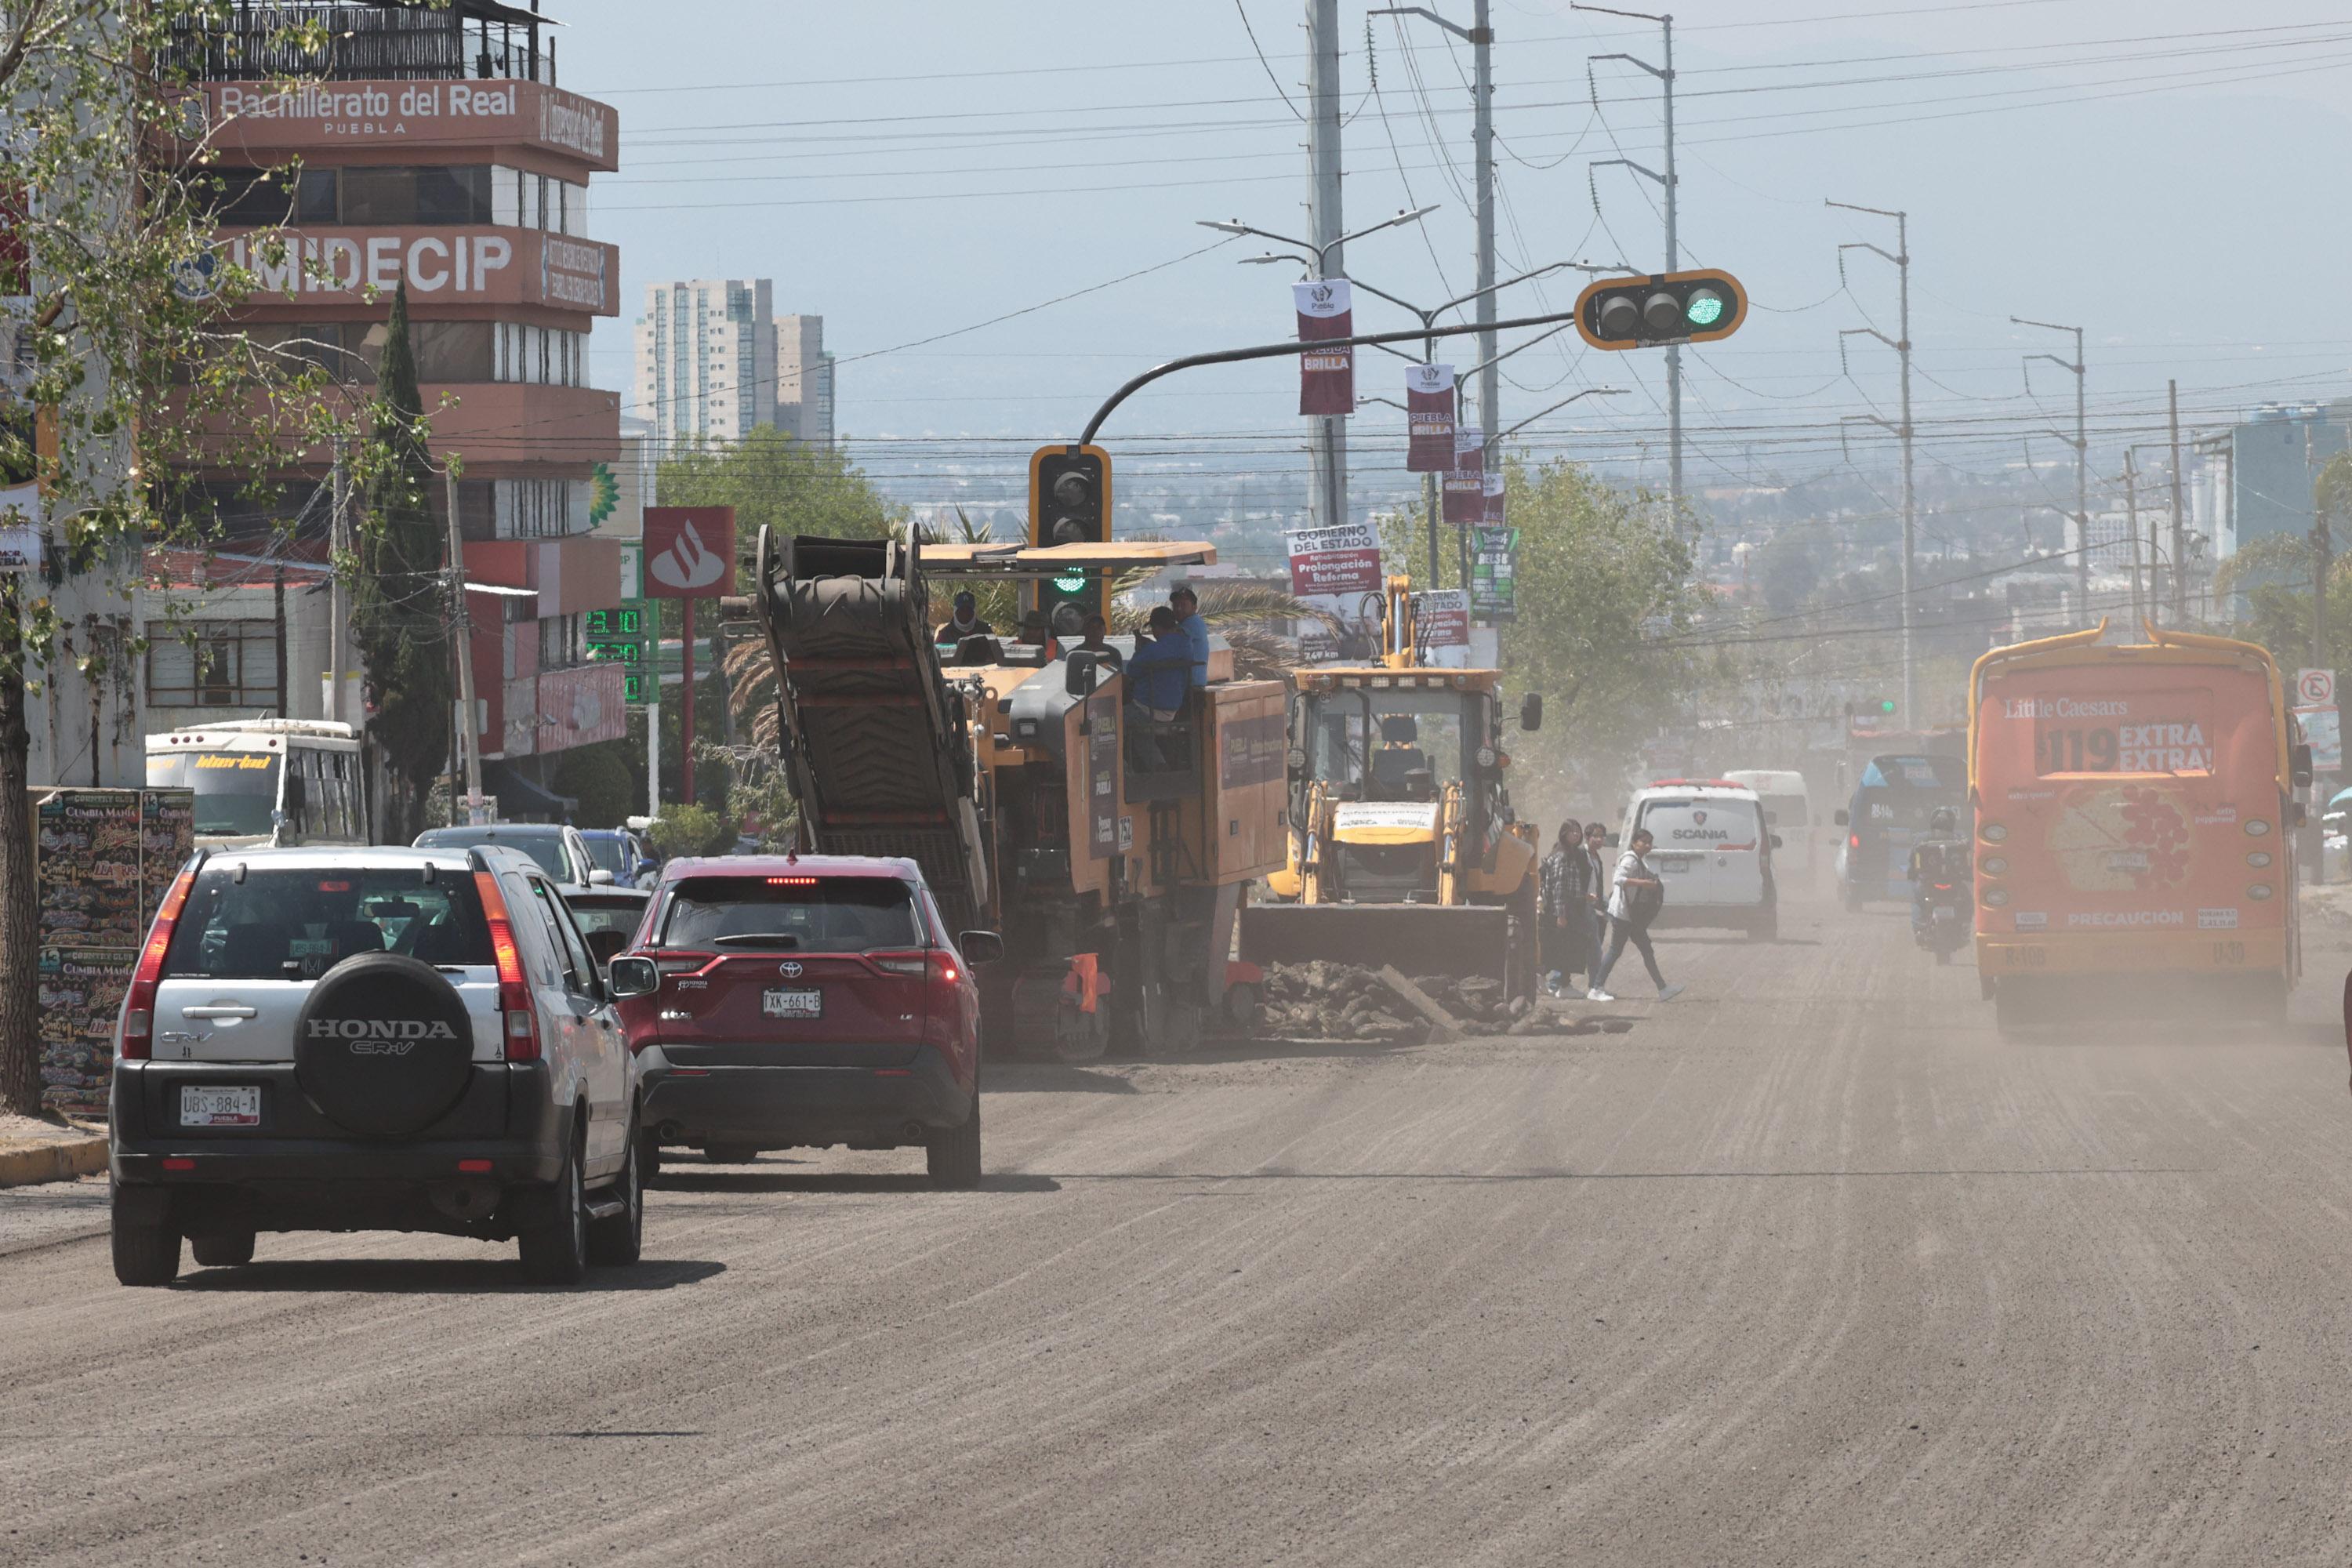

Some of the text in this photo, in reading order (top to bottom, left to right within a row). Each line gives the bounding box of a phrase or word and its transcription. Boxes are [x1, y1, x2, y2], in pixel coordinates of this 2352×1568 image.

[220, 84, 390, 119] Bachillerato
[399, 85, 439, 118] del
[449, 85, 516, 117] Real
[325, 123, 406, 135] PUEBLA
[234, 236, 512, 292] IMIDECIP
[1304, 358, 1349, 371] BRILLA
[1410, 412, 1453, 423] PUEBLA
[1412, 424, 1452, 436] BRILLA
[1446, 481, 1482, 491] BRILLA
[1297, 525, 1368, 542] GOBIERNO
[1294, 536, 1373, 554] DEL ESTADO
[1298, 559, 1374, 573] Prolongación
[1312, 572, 1360, 583] Reforma
[2004, 697, 2129, 719] Little Caesars
[2119, 723, 2204, 747] EXTRA
[2119, 747, 2212, 771] EXTRA!
[1120, 819, 1131, 840] 752
[1671, 829, 1728, 840] SCANIA
[2067, 909, 2184, 927] PRECAUCIÓN
[39, 949, 61, 967] 13
[2212, 941, 2244, 965] U-30
[764, 995, 821, 1009] TXK-661-B
[160, 1031, 214, 1044] CR-V
[307, 1018, 458, 1040] HONDA
[350, 1040, 416, 1055] CR-V
[183, 1095, 257, 1114] UBS-884-A
